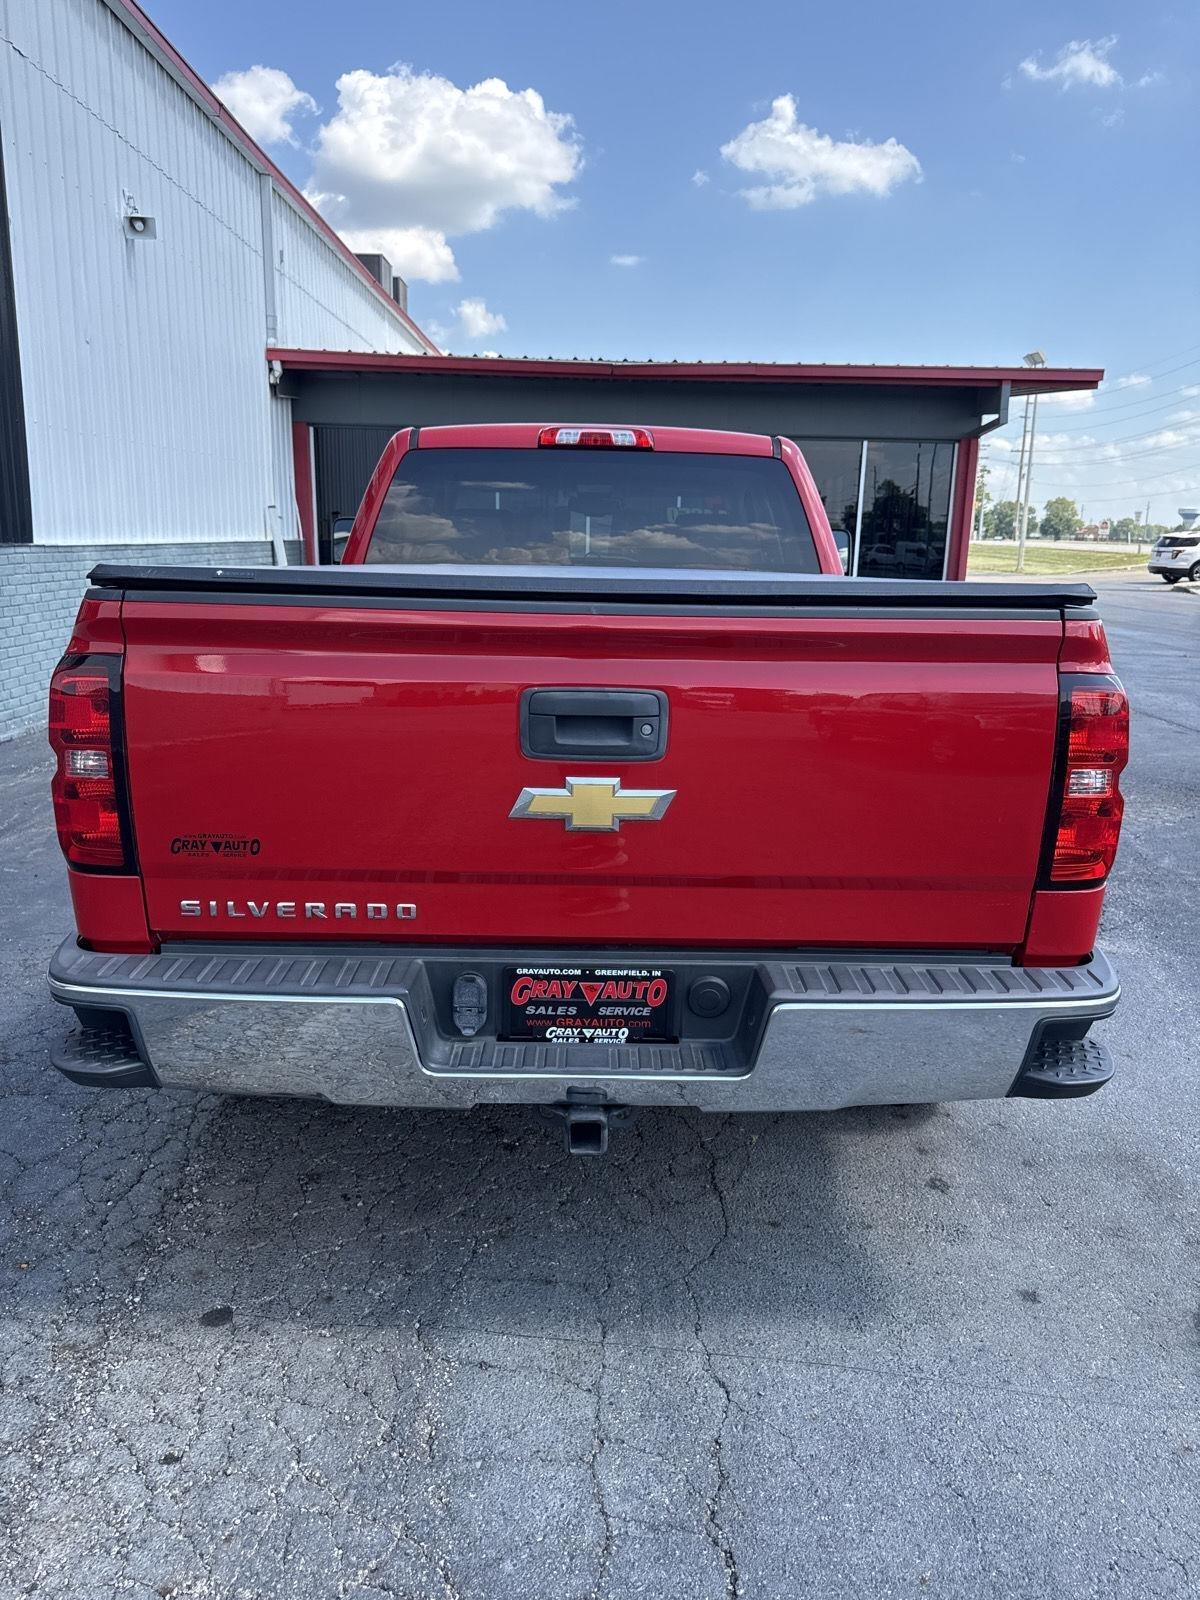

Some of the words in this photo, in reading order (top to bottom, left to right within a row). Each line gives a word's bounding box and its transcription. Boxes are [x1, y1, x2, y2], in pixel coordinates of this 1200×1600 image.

[171, 838, 207, 854] GRAY
[223, 838, 260, 856] AUTO
[180, 900, 417, 919] SILVERADO
[516, 968, 582, 976] GRAYAUTO.COM
[511, 976, 578, 1006] GRAY
[600, 978, 668, 1007] AUTO
[525, 1005, 578, 1016] SALES
[598, 1006, 652, 1016] SERVICE
[545, 1026, 581, 1039] GRAY
[593, 1027, 629, 1039] AUTO
